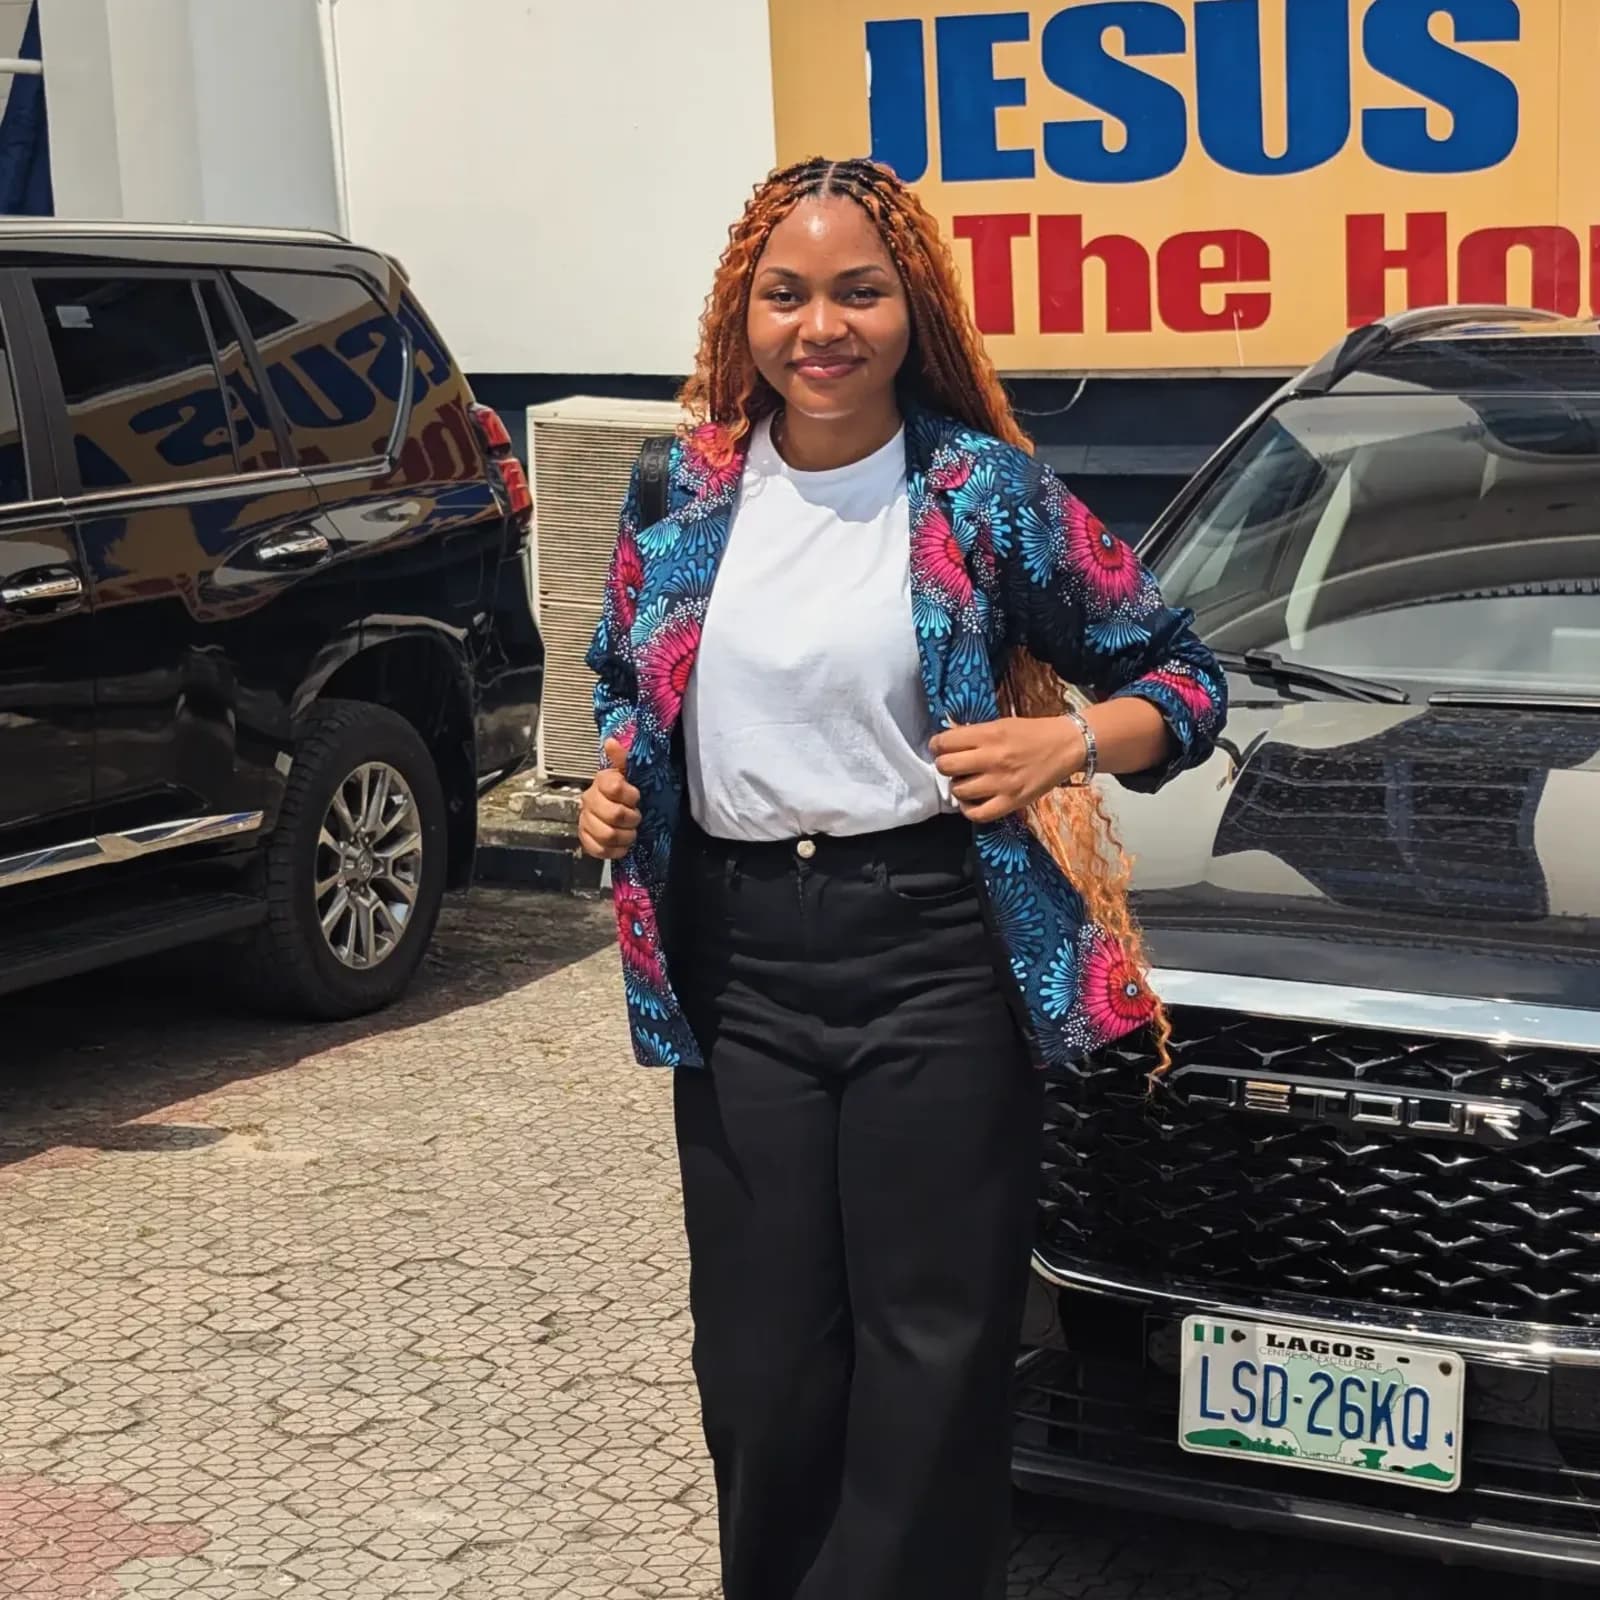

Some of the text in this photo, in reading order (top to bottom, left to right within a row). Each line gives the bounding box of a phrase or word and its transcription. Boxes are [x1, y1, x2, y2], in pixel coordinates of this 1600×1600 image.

[865, 0, 1521, 184] JESUS
[953, 211, 1600, 335] The Ho
[1188, 1078, 1522, 1141] JETOUR
[1266, 1333, 1375, 1361] LAGOS
[1199, 1355, 1430, 1451] LSD-26KQ
